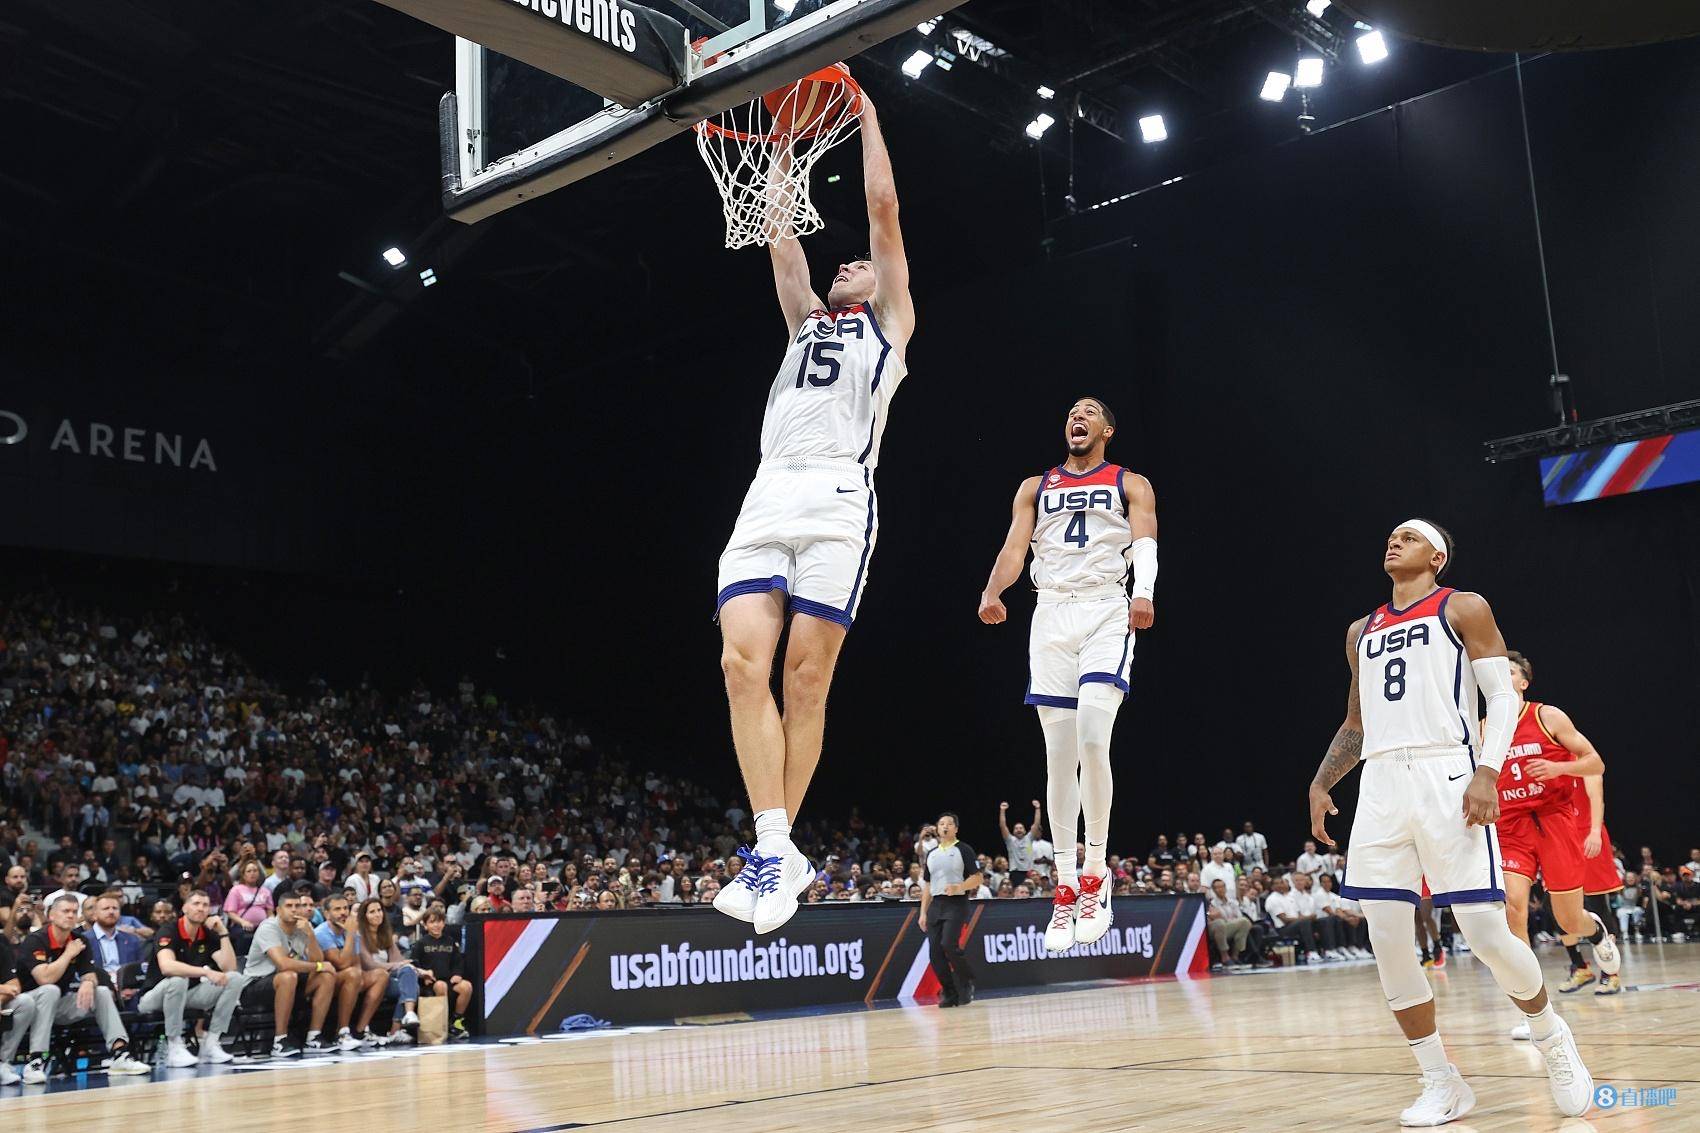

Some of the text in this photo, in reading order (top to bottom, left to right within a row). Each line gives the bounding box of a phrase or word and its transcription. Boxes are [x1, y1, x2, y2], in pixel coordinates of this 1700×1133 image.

[796, 342, 845, 389] 15
[50, 418, 217, 472] ARENA
[1043, 489, 1112, 514] USA
[1064, 510, 1089, 548] 4
[1366, 623, 1429, 659] USA
[1383, 657, 1406, 701] 8
[1510, 762, 1522, 781] 9
[1502, 787, 1527, 801] ING
[983, 924, 1153, 963] usabfoon.org
[610, 937, 865, 990] usabfoundation.org
